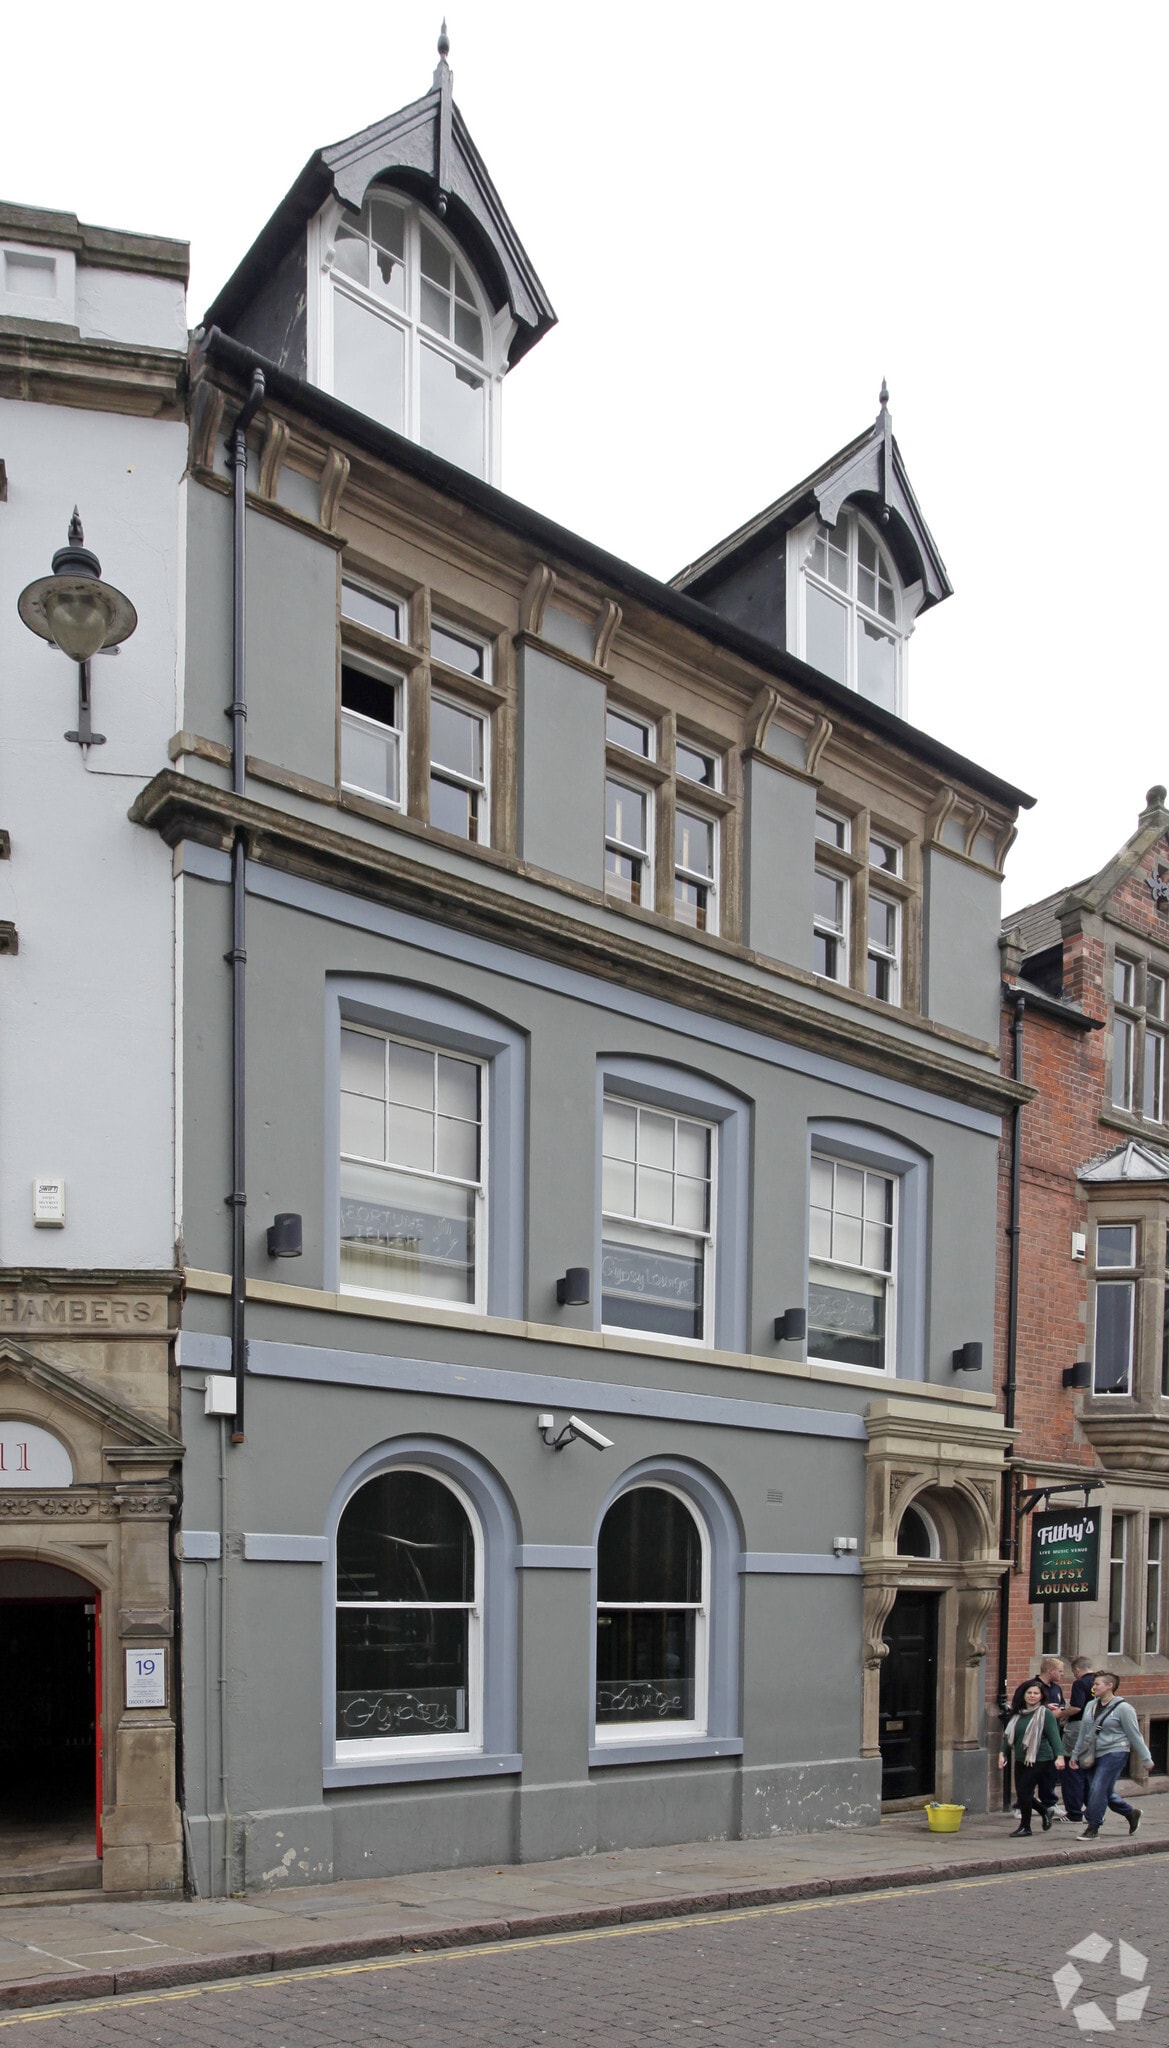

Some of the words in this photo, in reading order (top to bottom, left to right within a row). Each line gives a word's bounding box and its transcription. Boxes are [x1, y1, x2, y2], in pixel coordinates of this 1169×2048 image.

[39, 1185, 58, 1193] SWIFT
[345, 1204, 425, 1234] FORTUNE
[1037, 1517, 1095, 1546] Filthy's
[1055, 1558, 1073, 1566] THE
[1041, 1568, 1084, 1580] GYPSY
[1036, 1582, 1089, 1595] LOUNGE
[135, 1659, 156, 1676] 19
[341, 1692, 458, 1732] Gypsy
